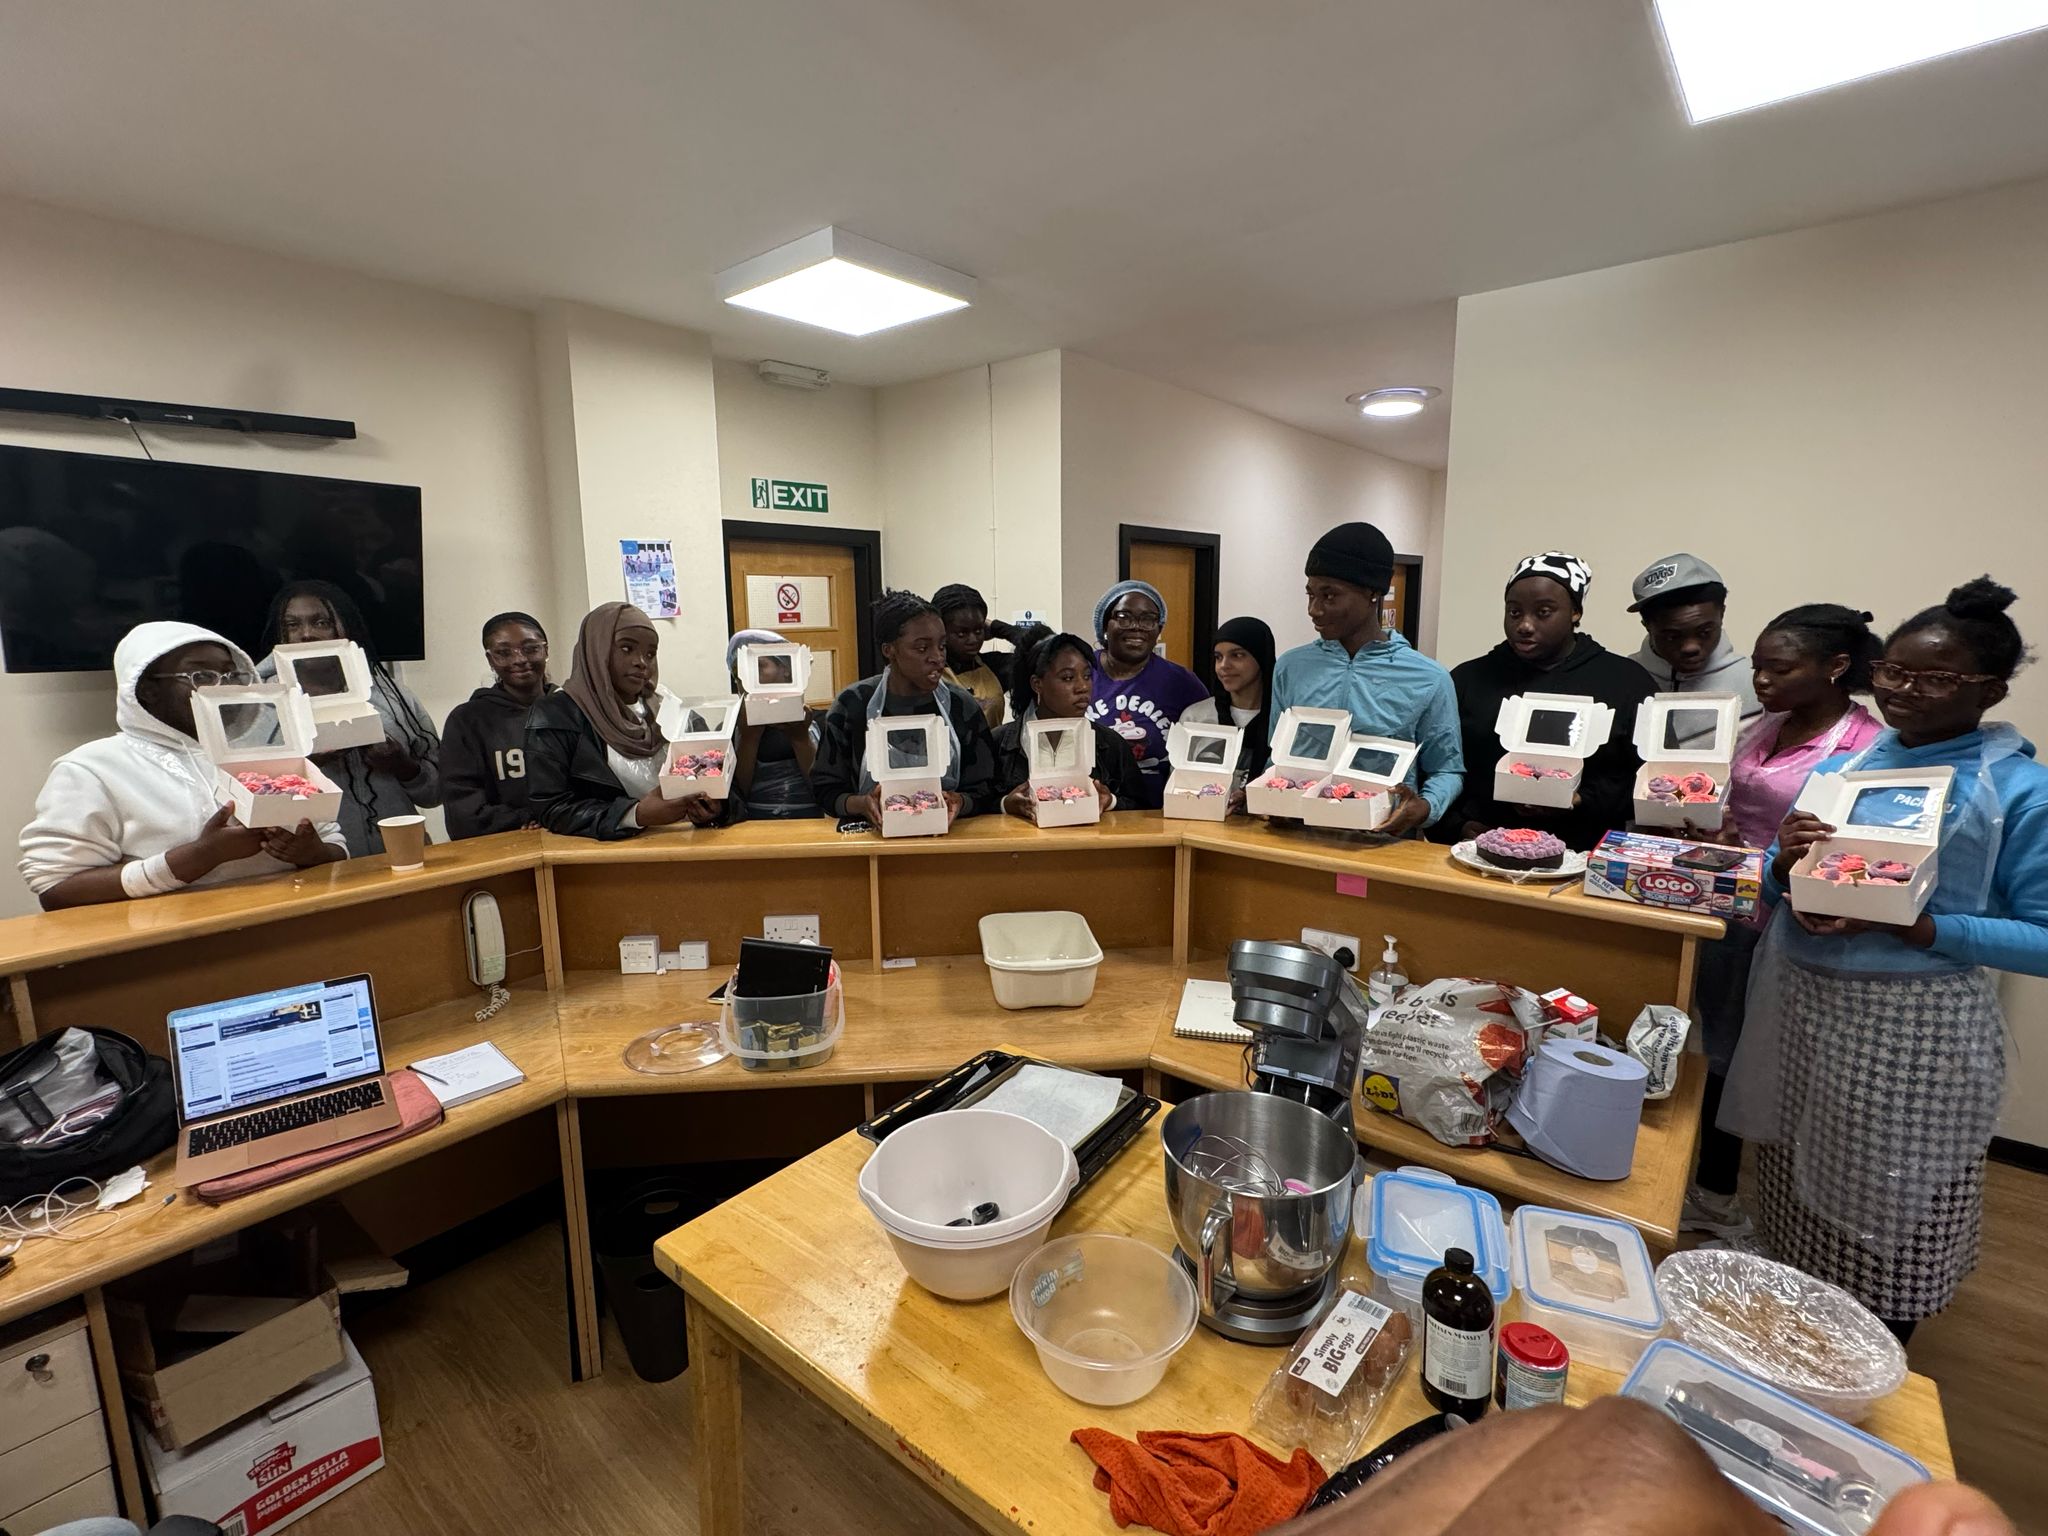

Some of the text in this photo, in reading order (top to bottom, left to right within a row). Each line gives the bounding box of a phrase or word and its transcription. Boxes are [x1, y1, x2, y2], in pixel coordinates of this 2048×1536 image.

[773, 485, 827, 509] EXIT
[1643, 567, 1675, 587] KINGS
[1084, 699, 1109, 722] KE
[495, 748, 526, 781] 19
[1590, 873, 1617, 892] ALL NEW
[1646, 876, 1695, 893] LOGO
[1422, 1048, 1450, 1060] recycle
[1313, 1333, 1339, 1358] Simply
[1322, 1332, 1355, 1374] BIG eggs
[249, 1449, 294, 1477] TROPICAL
[258, 1461, 290, 1486] SUN
[255, 1451, 349, 1511] GOLDEN SELLA
